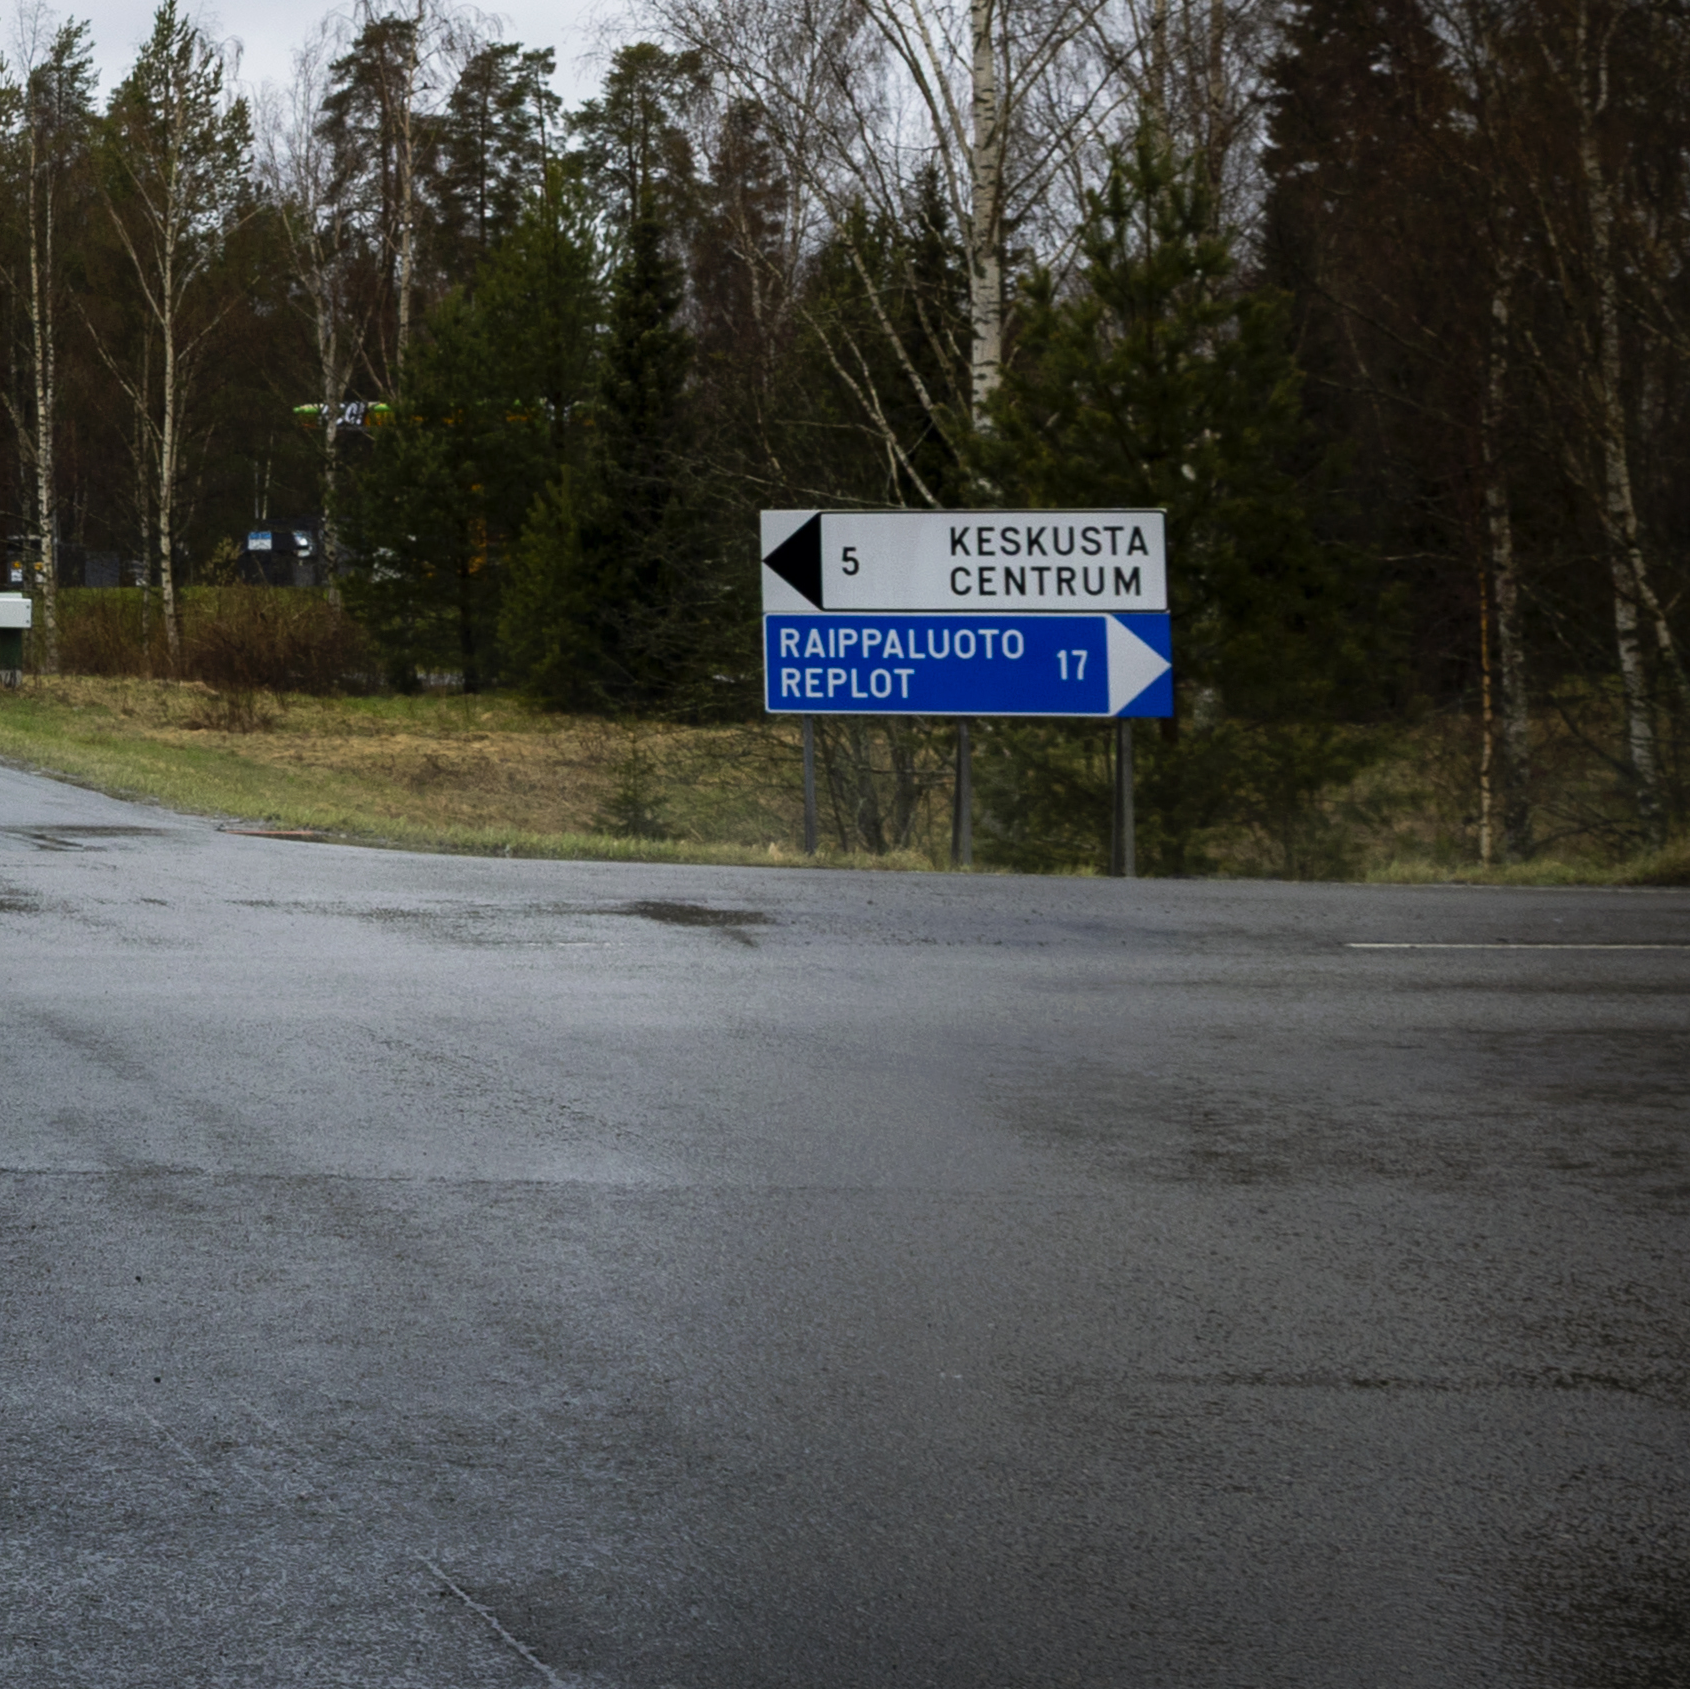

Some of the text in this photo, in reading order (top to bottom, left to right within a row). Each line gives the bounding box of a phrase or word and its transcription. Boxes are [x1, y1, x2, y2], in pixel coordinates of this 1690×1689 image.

[949, 525, 1149, 557] KESKUSTA
[840, 546, 861, 577] 5
[949, 566, 1142, 597] CENTRUM
[779, 628, 1025, 659] RAIPPALUOTO
[1056, 649, 1089, 681] 17
[780, 667, 916, 699] REPLOT
